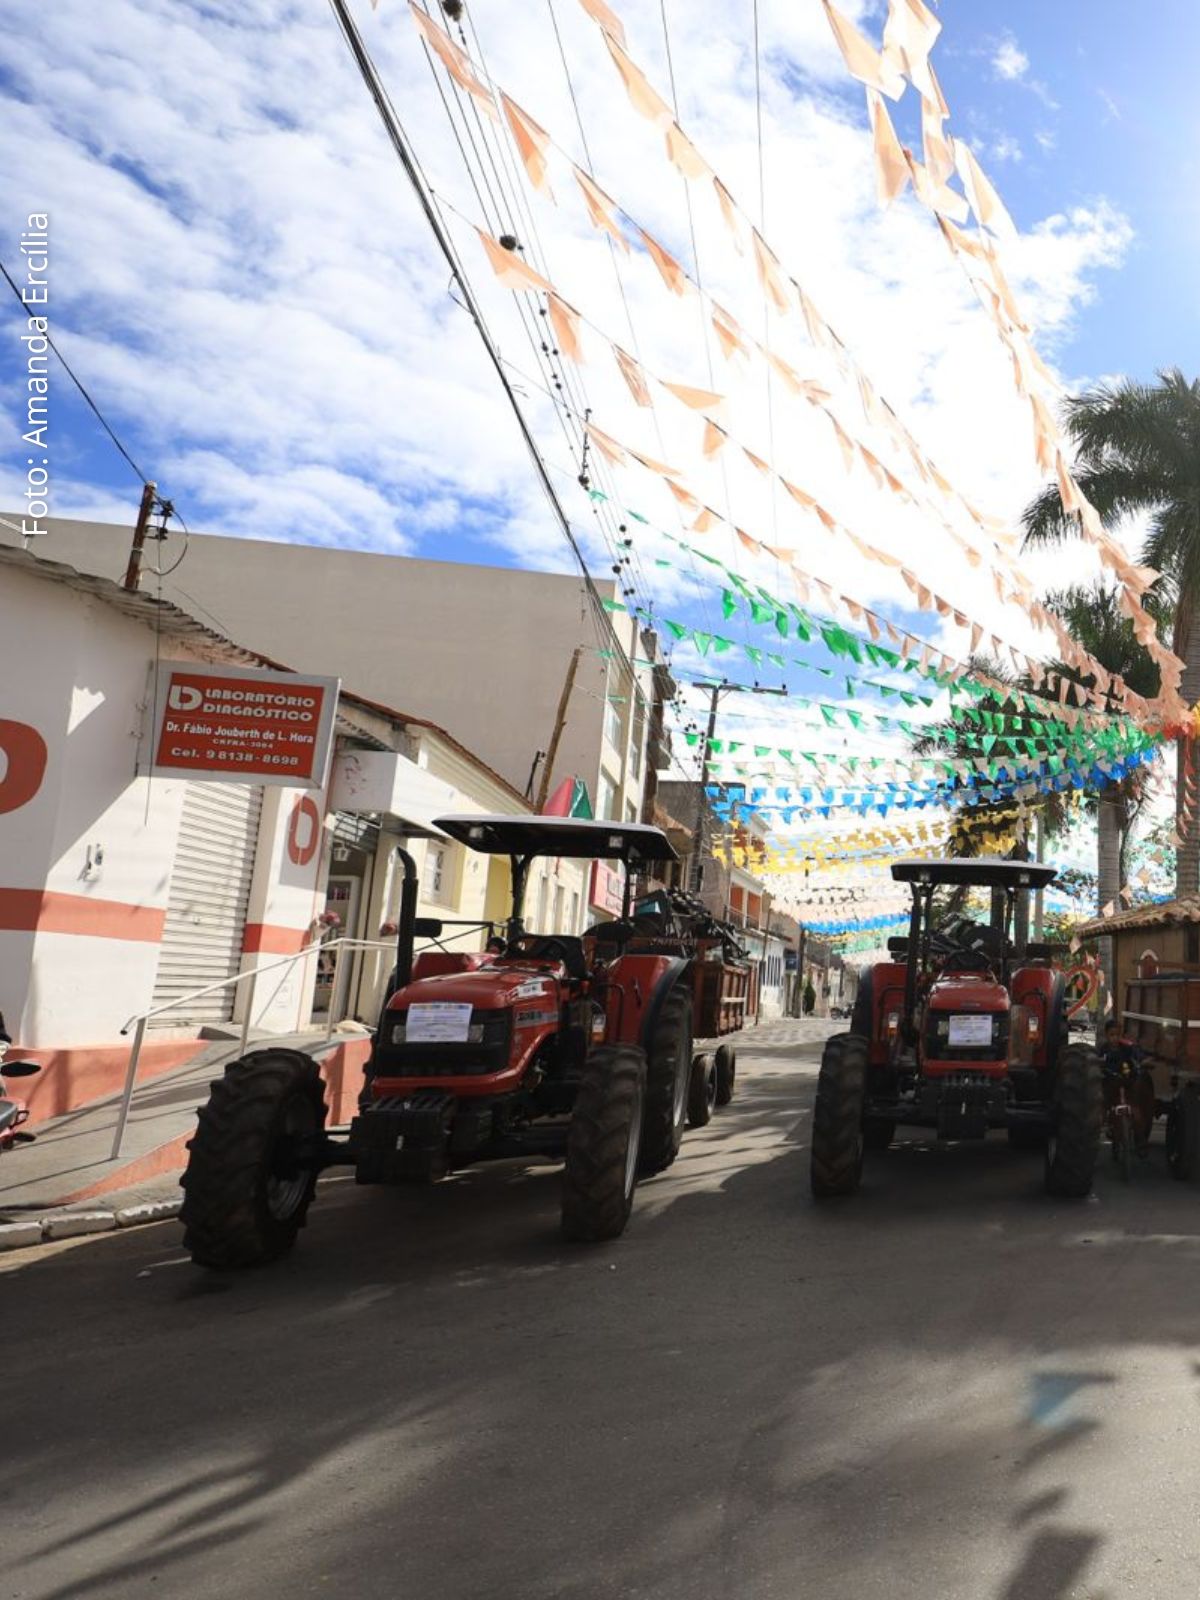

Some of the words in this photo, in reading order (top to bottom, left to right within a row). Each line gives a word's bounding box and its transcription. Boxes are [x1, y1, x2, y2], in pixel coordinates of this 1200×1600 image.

[205, 688, 315, 708] LABORATÓRIO
[202, 703, 313, 722] DIAGNÓSTICO
[166, 721, 181, 733] Dr.
[183, 722, 212, 736] Fábio
[214, 726, 260, 740] Jouberth
[262, 729, 275, 741] de
[277, 731, 287, 741] L.
[289, 733, 314, 745] Hora
[171, 747, 200, 759] Cel.
